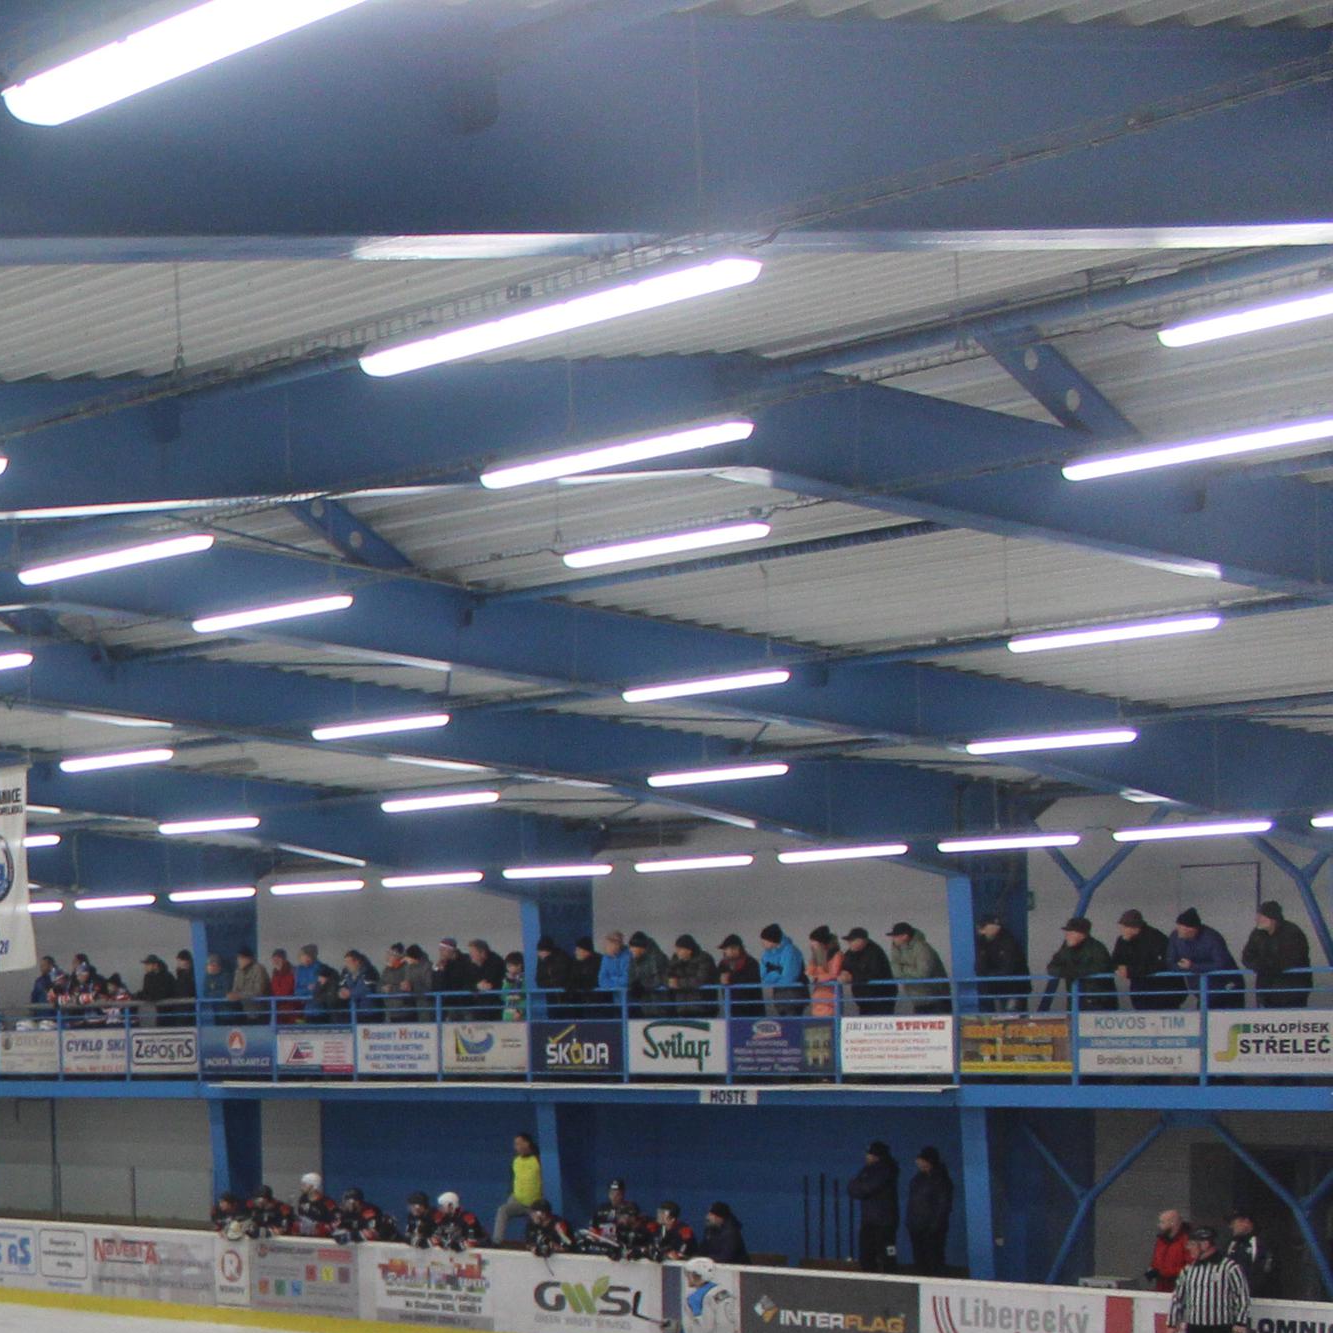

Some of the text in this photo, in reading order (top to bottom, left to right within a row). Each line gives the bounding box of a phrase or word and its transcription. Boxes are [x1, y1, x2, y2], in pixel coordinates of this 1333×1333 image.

[1094, 1016, 1146, 1030] KOVOS
[1160, 1016, 1186, 1029] TIM
[1253, 1021, 1330, 1033] SKLOPÍSEK
[643, 1020, 711, 1072] Svitap
[1239, 1036, 1332, 1054] STŘELEČ
[1147, 1054, 1174, 1065] Lhota
[94, 1237, 161, 1265] NOVESTA
[779, 1309, 906, 1333] INTERFLAG
